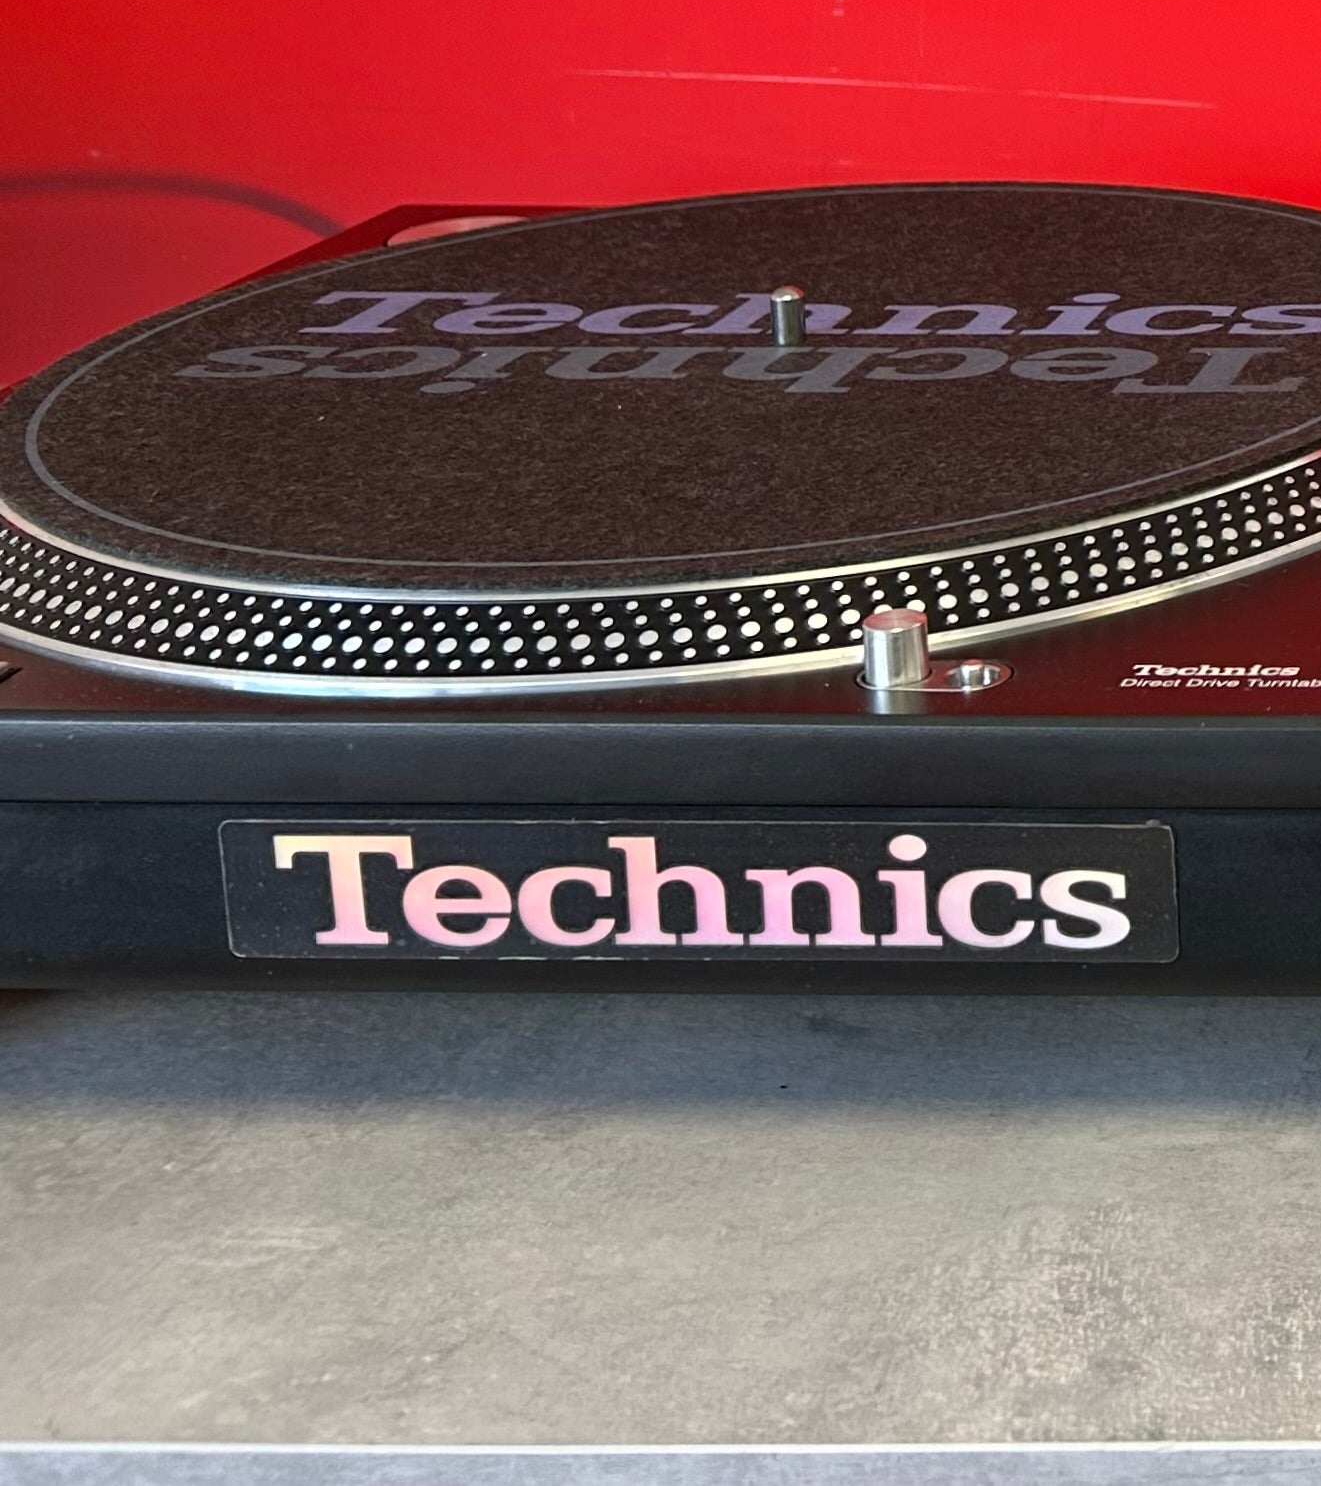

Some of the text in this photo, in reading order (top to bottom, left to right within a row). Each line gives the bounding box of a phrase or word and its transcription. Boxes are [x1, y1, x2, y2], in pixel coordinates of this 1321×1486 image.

[172, 344, 1304, 395] Technics
[1119, 677, 1182, 689] Direct
[1185, 677, 1241, 689] Drive
[1132, 664, 1301, 677] Technics
[272, 834, 1132, 949] Technics
